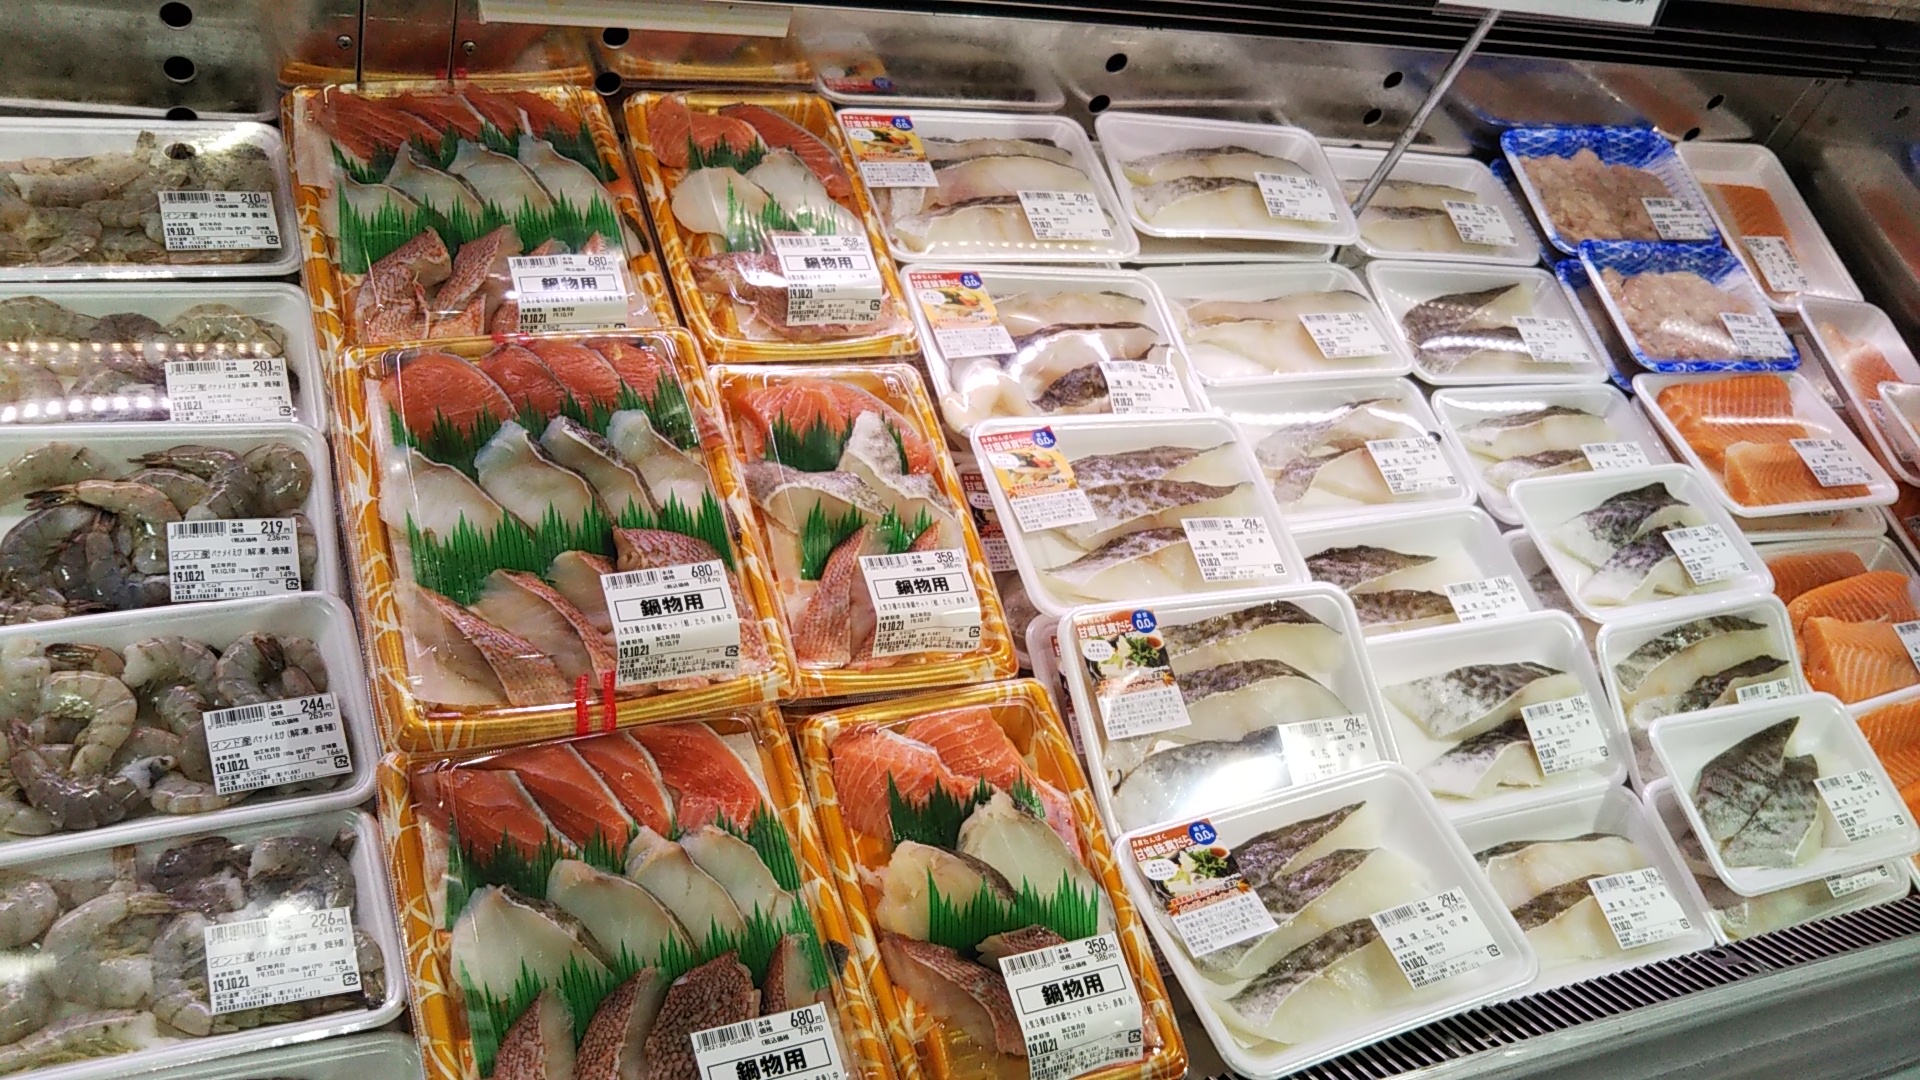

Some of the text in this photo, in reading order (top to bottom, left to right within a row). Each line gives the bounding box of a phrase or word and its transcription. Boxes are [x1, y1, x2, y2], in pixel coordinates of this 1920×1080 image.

[166, 227, 196, 236] 19.10.21
[804, 256, 853, 270] 鍋物用
[541, 276, 599, 291] 鍋物用
[789, 288, 813, 299] 19.10.21
[519, 313, 547, 324] 19.10.21
[173, 401, 204, 411] 19.10.21
[260, 520, 292, 534] 219円
[172, 550, 210, 560] インド産
[935, 551, 960, 563] 358円
[173, 570, 206, 583] 19.10.21
[691, 563, 720, 578] 680円
[895, 577, 951, 595] 鍋物用
[640, 593, 704, 617] 鍋物用
[878, 620, 905, 632] 19.10.21
[618, 644, 650, 659] 19.10.21
[300, 696, 333, 714] 244円
[211, 737, 252, 750] インド産
[297, 753, 311, 761] 147
[214, 758, 250, 776] 19.10.21
[1194, 830, 1215, 845] 0.0g
[1437, 891, 1465, 908] 294円
[310, 911, 345, 928] 226円
[1084, 937, 1116, 955] 358円
[212, 952, 255, 967] インド産
[1401, 955, 1429, 973] 19.10.21
[302, 969, 319, 978] 147
[212, 974, 250, 994] 19.10.21
[1041, 973, 1105, 1006] 鍋物用
[790, 1008, 822, 1028] 680円
[799, 1024, 824, 1037] 734円）
[1028, 1037, 1059, 1058] 19.10.21
[735, 1047, 808, 1080] 鍋物用
